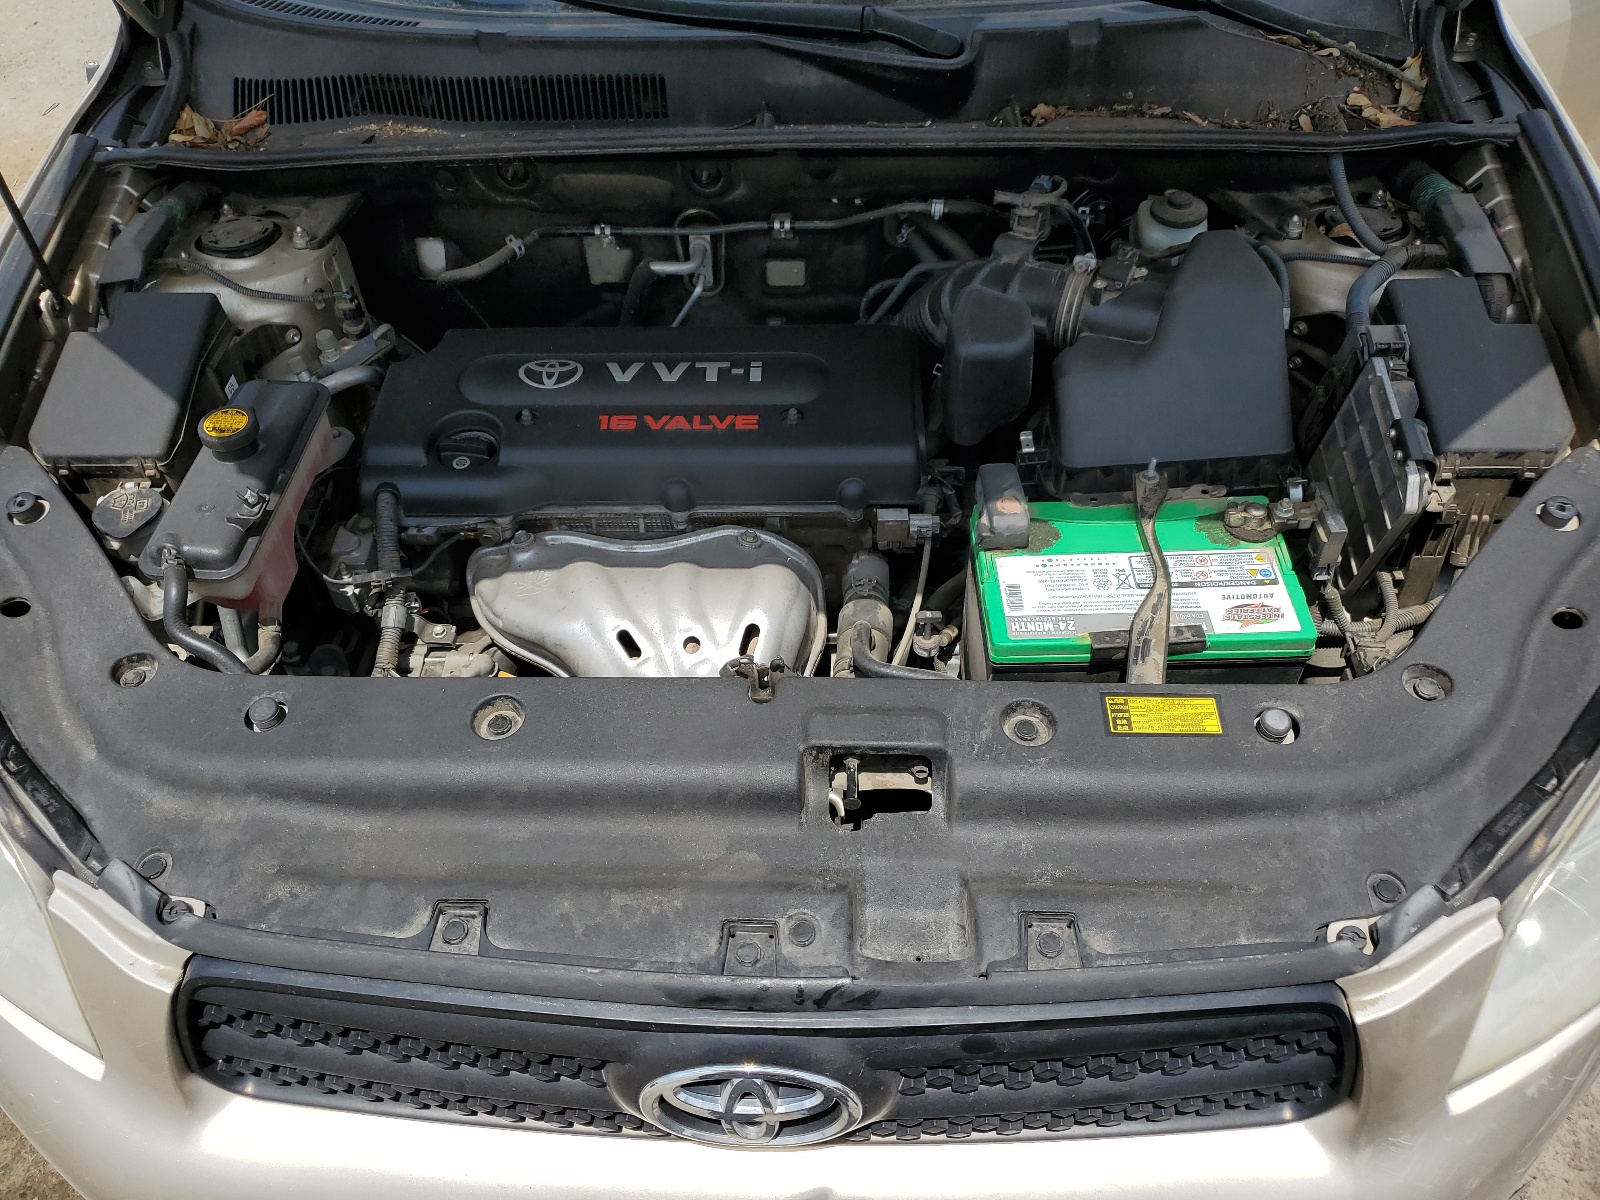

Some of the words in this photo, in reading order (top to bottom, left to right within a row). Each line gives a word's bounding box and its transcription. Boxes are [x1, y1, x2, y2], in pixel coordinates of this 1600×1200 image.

[604, 361, 764, 382] VVT-i
[599, 414, 637, 431] 16
[643, 414, 760, 431] VALVE
[1223, 613, 1284, 621] INTERSTATE
[1011, 621, 1075, 631] 24-MONTH
